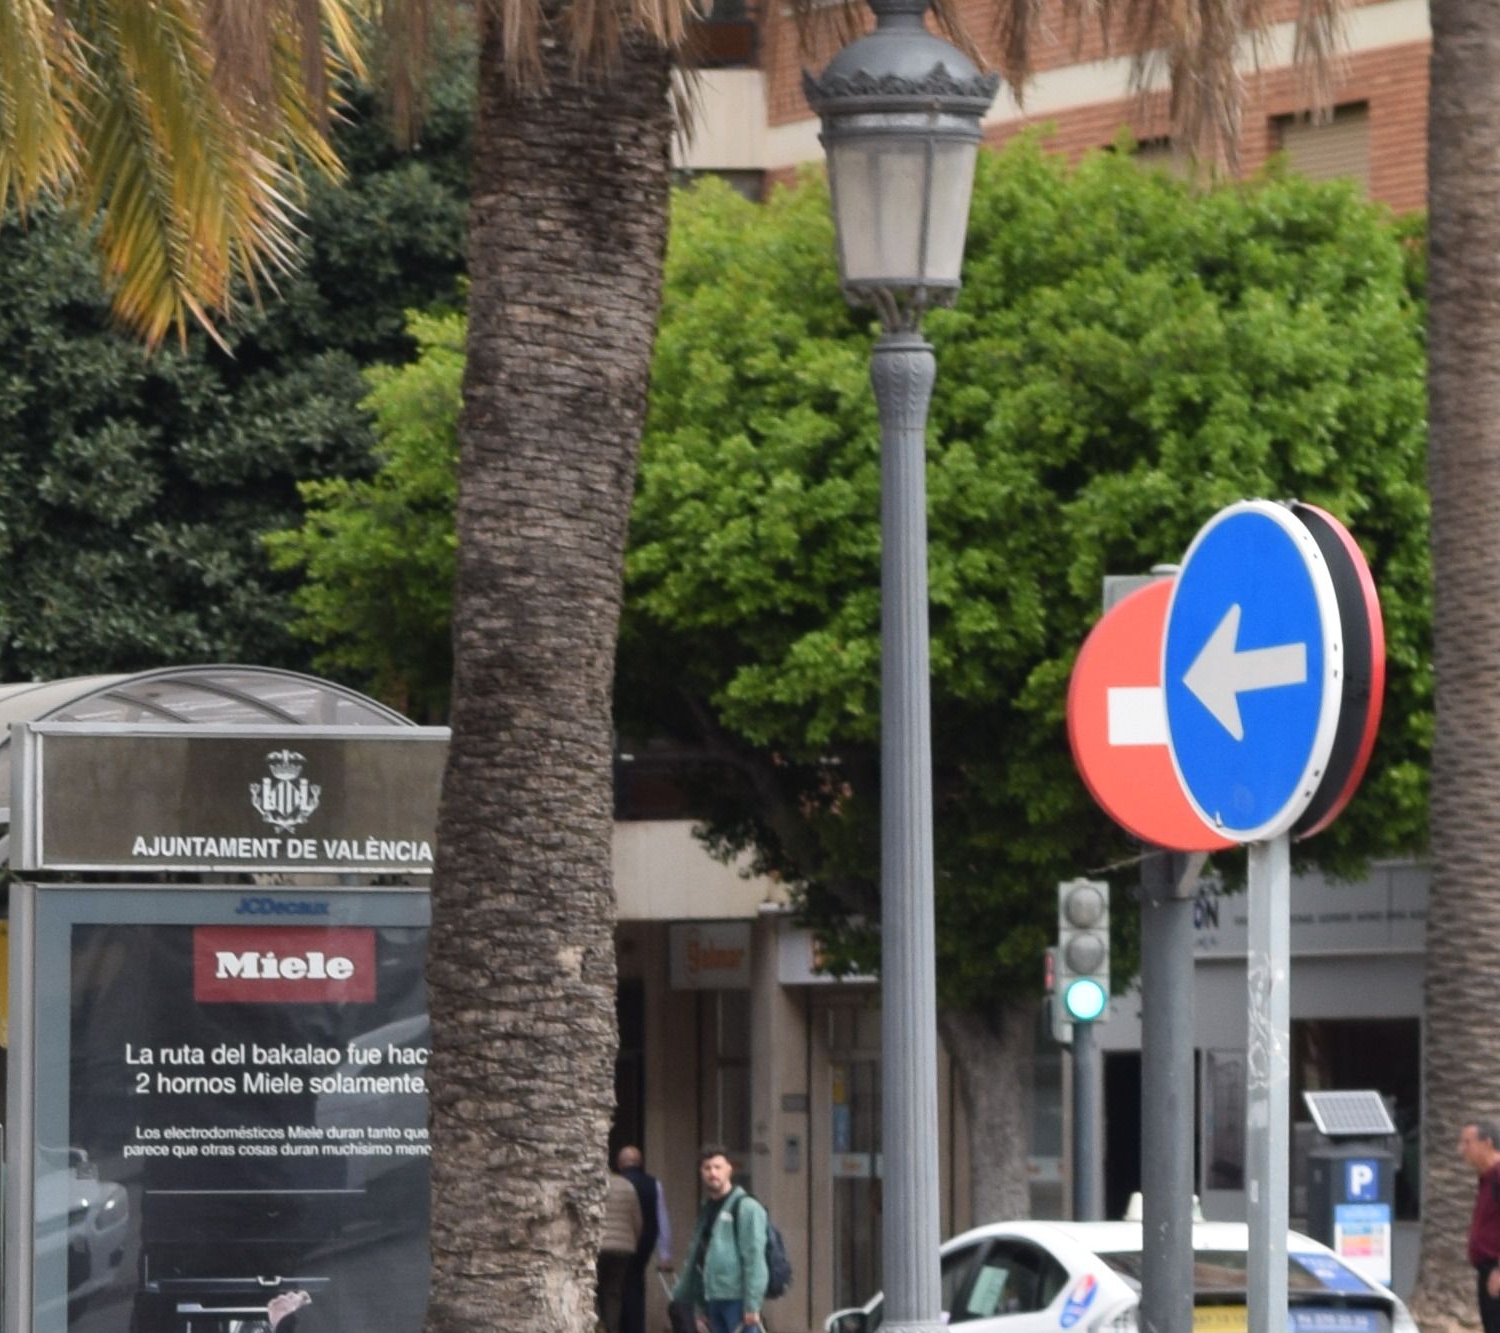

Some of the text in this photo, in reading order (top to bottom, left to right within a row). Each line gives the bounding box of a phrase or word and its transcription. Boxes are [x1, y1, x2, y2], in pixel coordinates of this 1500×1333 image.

[132, 836, 434, 862] AJUNTAMENT DE VALÈNCIA
[215, 951, 354, 980] Miele
[125, 1042, 432, 1065] La ruta del bakalao fue hac
[135, 1072, 429, 1094] 2 hornos Miele solamente.
[136, 1125, 429, 1141] Los electrodomésticos Miele duran tanto que
[123, 1145, 169, 1158] parece
[172, 1145, 198, 1158] que
[201, 1143, 235, 1156] otras
[238, 1145, 278, 1156] cosas
[280, 1143, 319, 1156] duran
[321, 1142, 393, 1156] muchísimo
[1350, 1164, 1373, 1196] P
